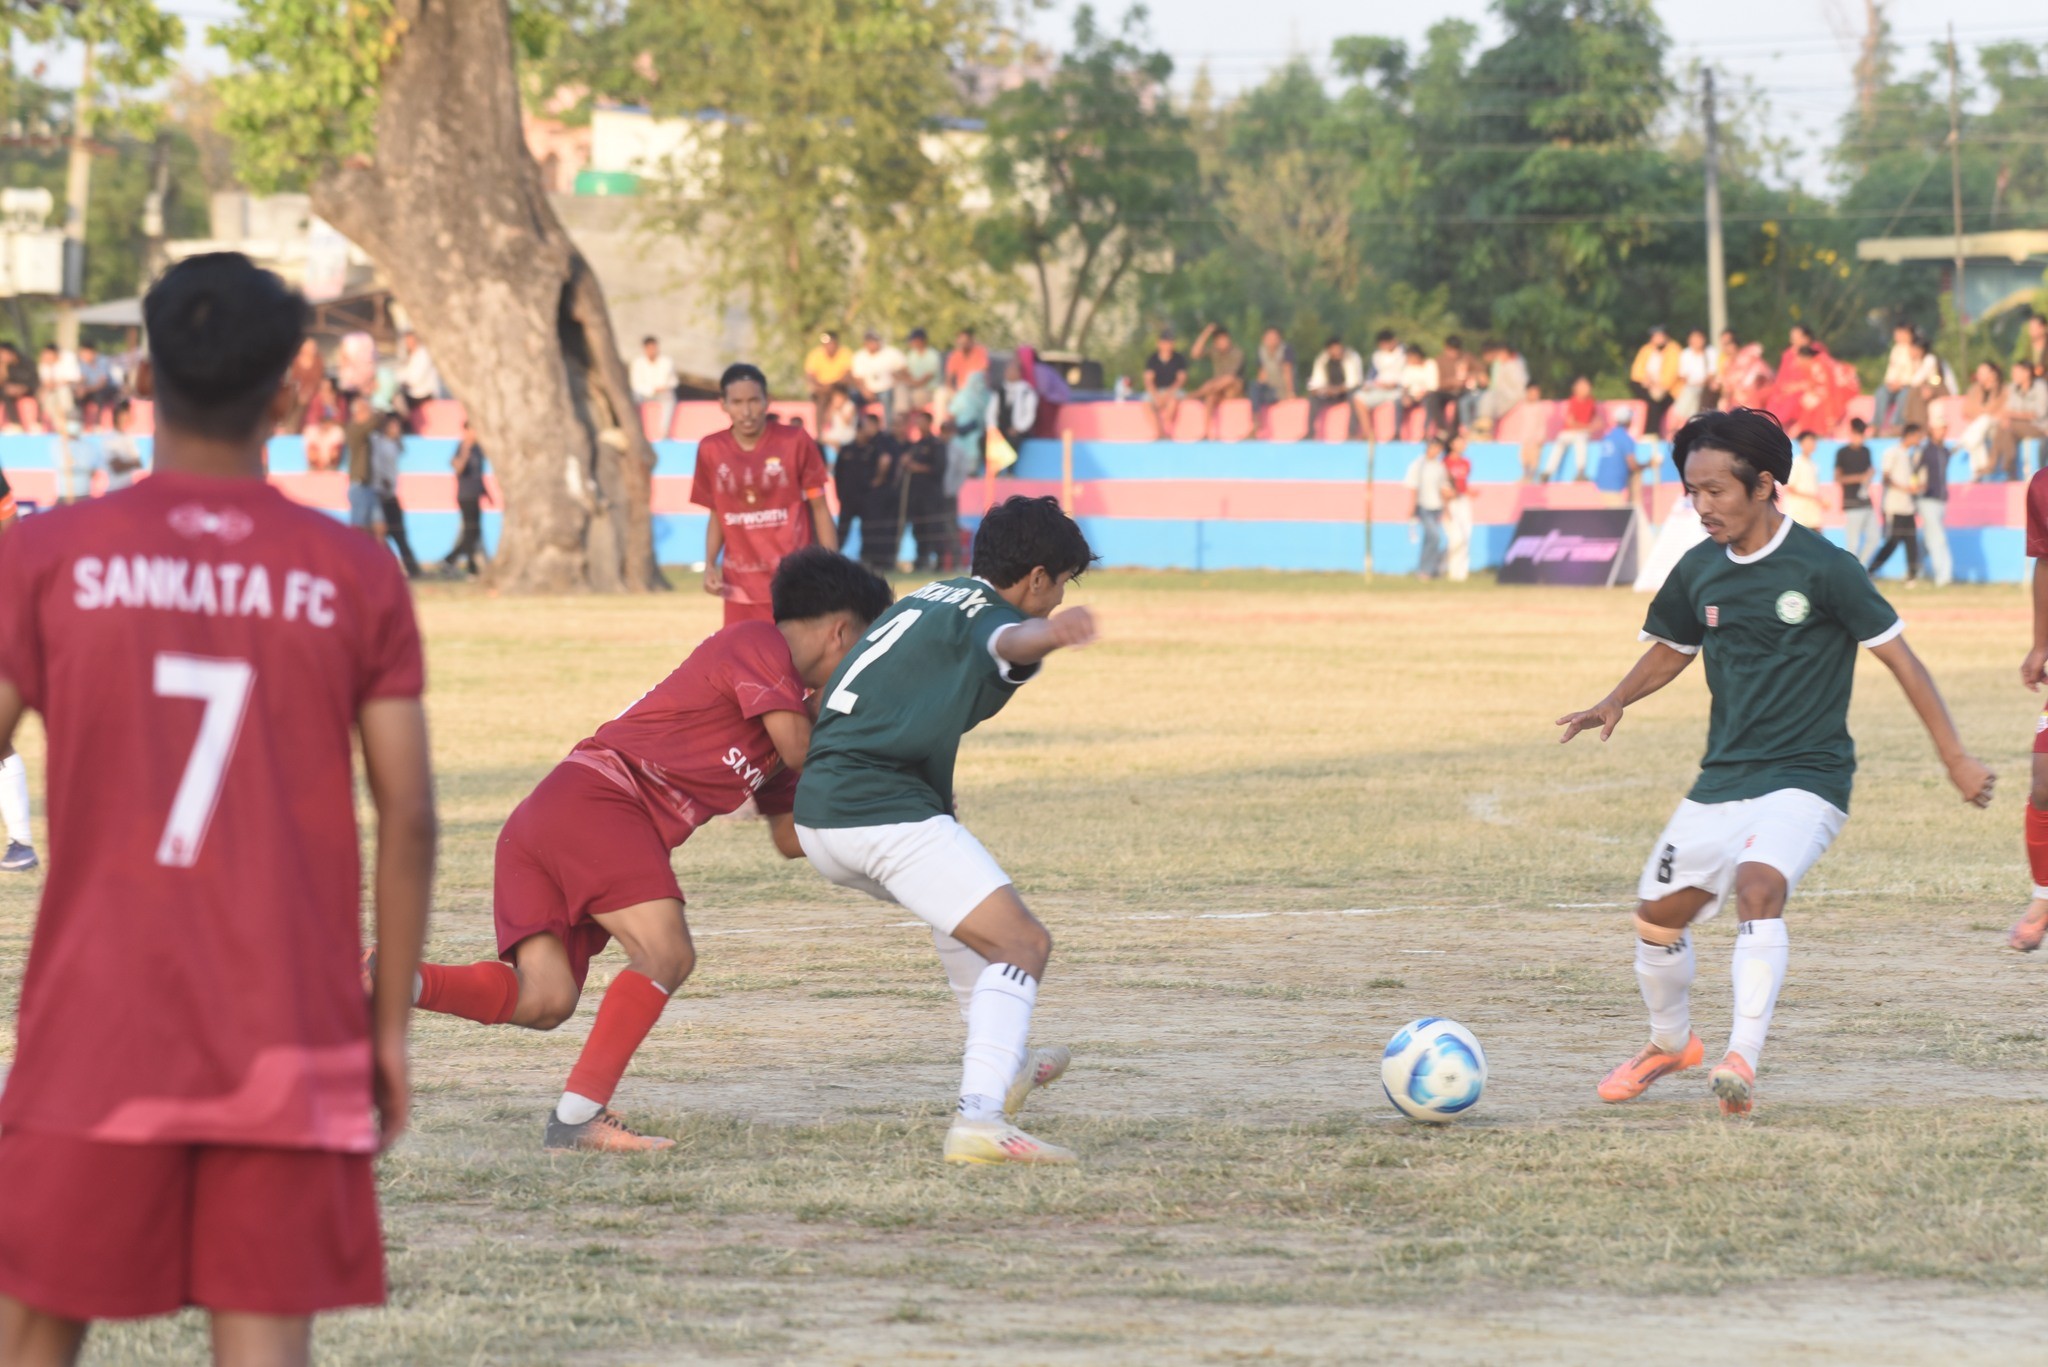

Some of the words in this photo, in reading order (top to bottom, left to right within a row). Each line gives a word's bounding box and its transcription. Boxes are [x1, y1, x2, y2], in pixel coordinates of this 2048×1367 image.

[74, 555, 271, 618] SANKATA
[283, 571, 337, 627] FC
[826, 608, 923, 715] 2
[154, 653, 256, 867] 7
[722, 747, 764, 791] SKYW
